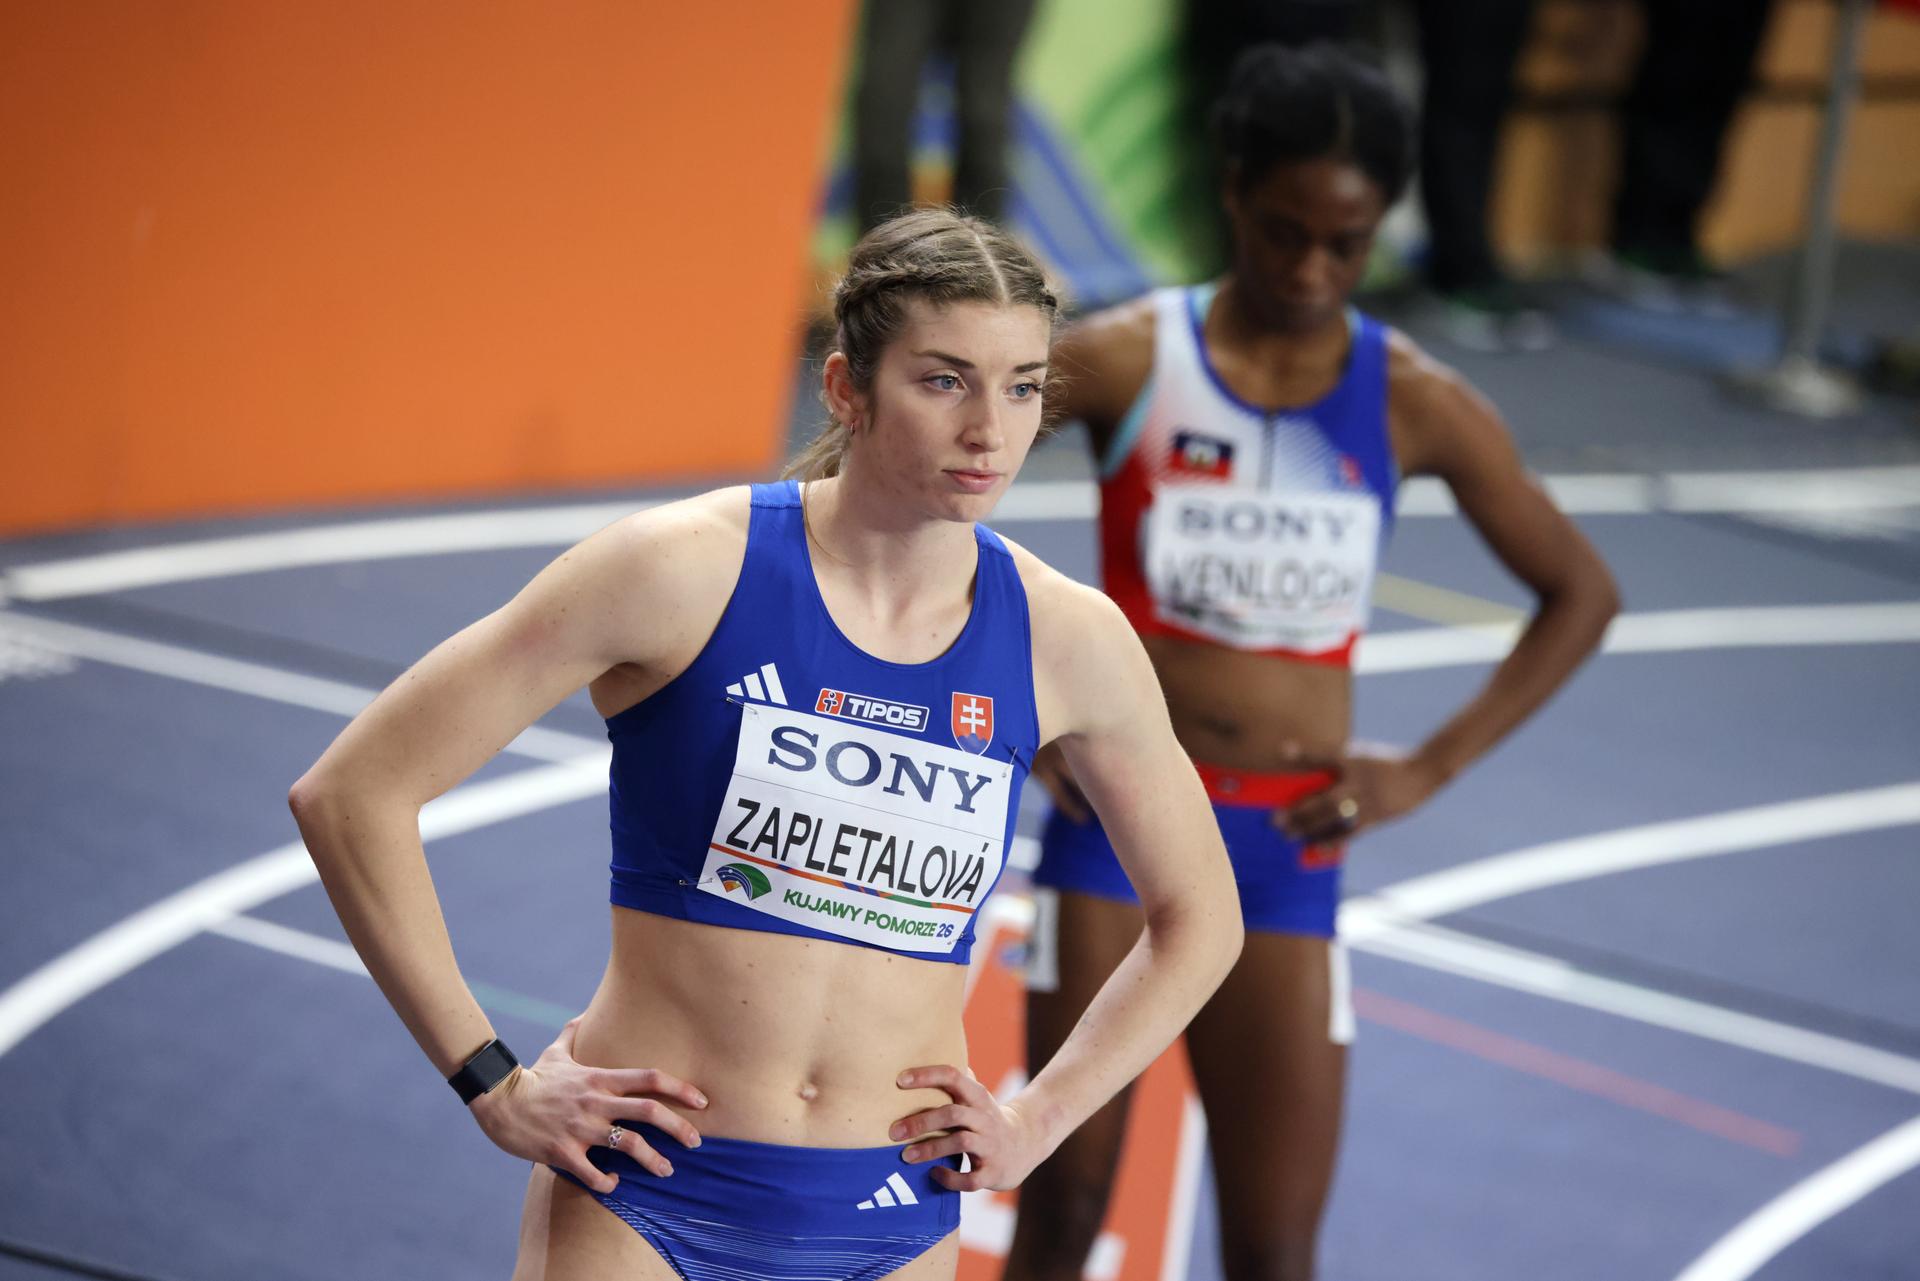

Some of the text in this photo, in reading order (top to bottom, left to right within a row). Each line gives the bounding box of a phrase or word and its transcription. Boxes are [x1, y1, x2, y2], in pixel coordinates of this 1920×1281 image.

[849, 698, 922, 728] TIPOS
[767, 726, 992, 813] SONY
[725, 798, 990, 903] ZAPLETALOVÁ
[783, 888, 954, 938] KUJAWY POMORZE 26
